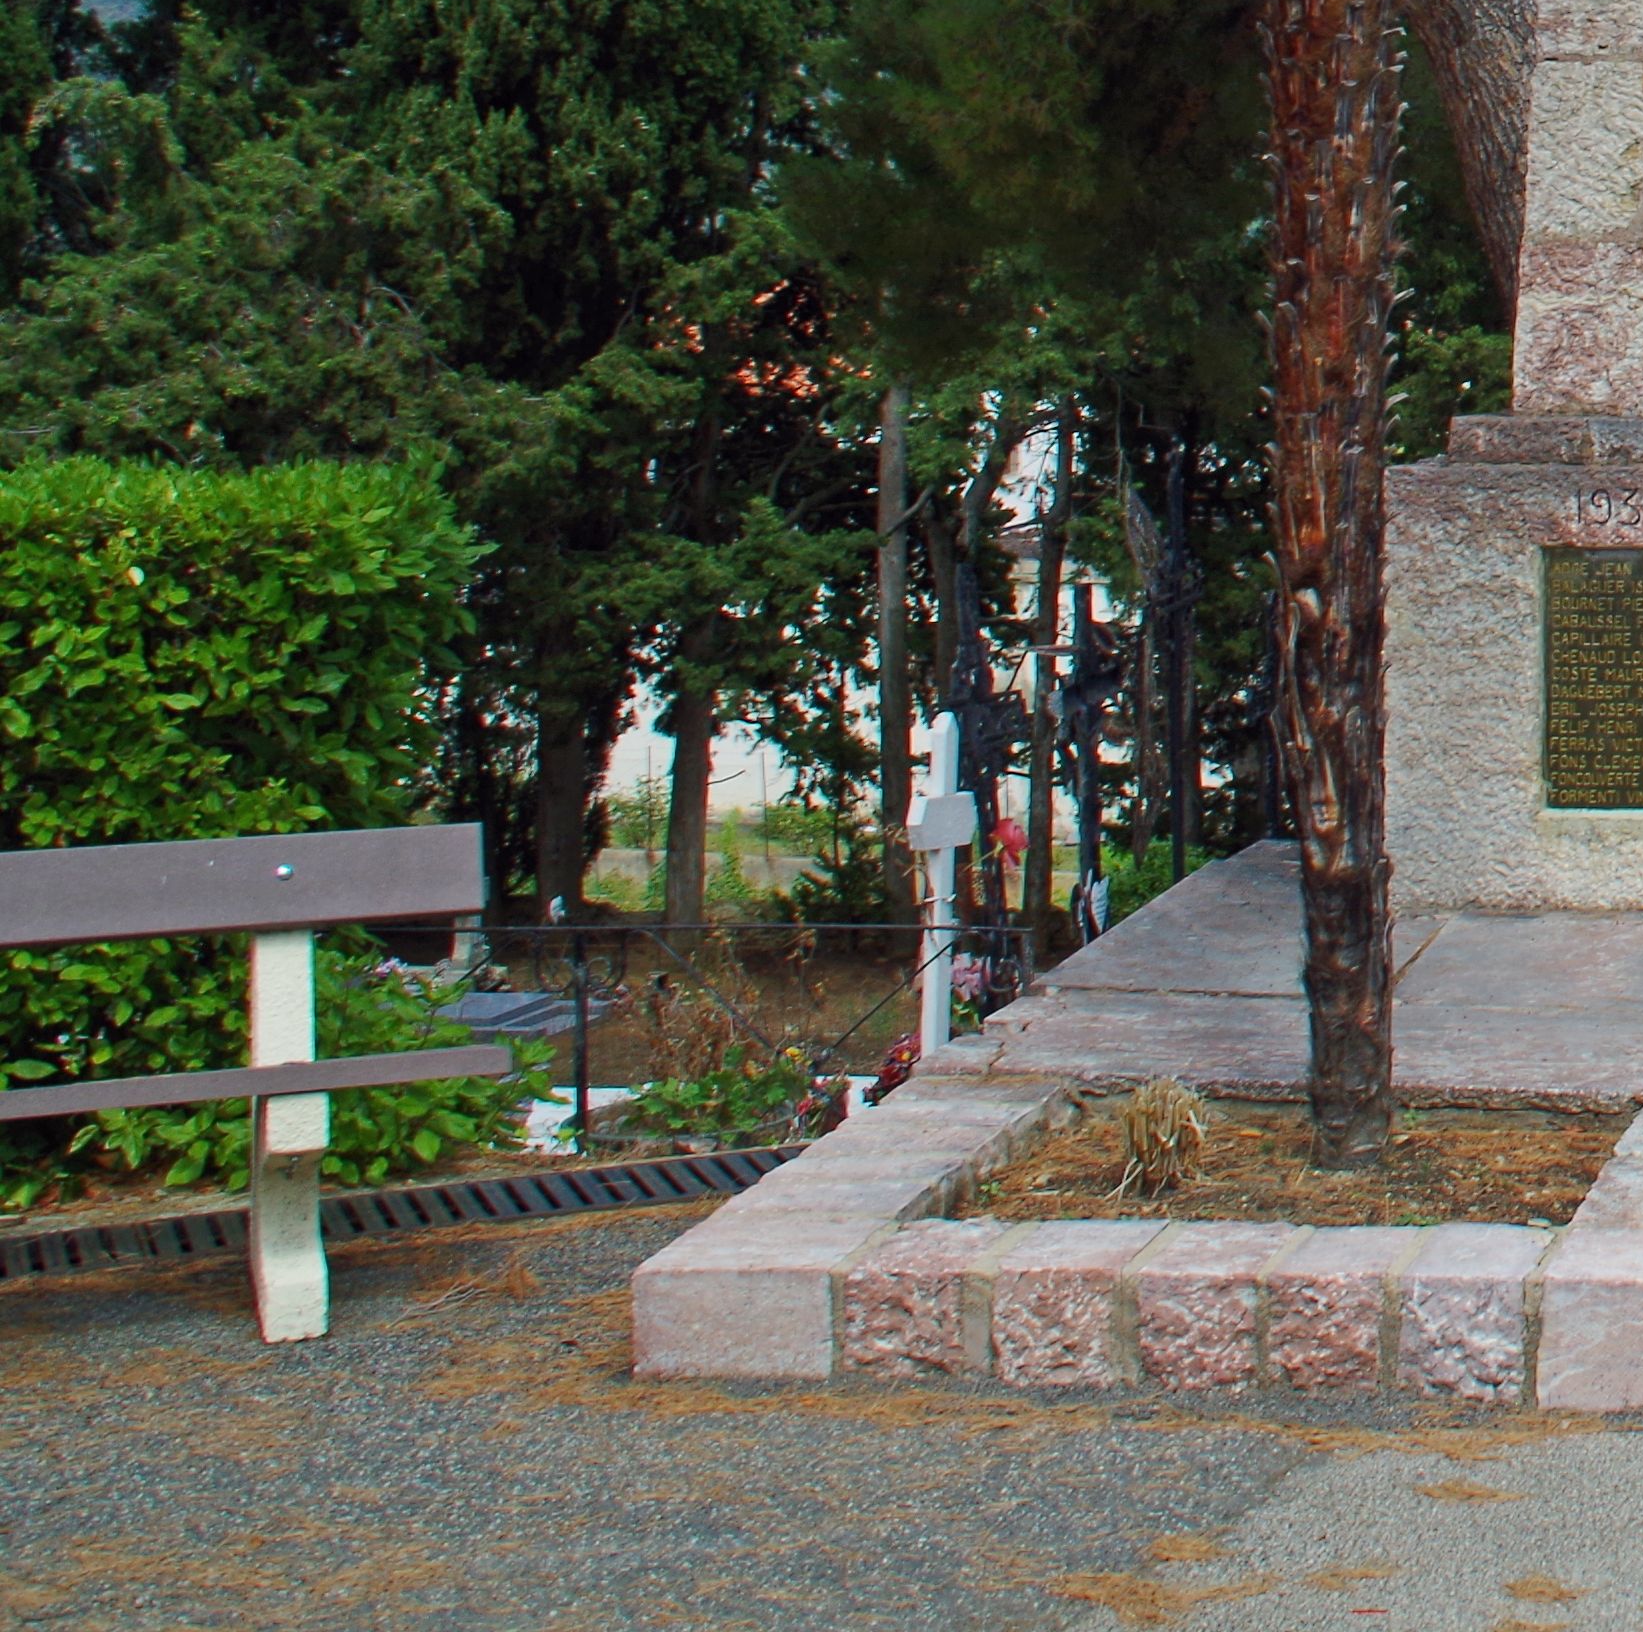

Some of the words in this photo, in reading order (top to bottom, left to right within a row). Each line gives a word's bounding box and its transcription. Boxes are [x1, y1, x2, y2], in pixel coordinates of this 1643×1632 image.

[1595, 562, 1632, 575] JEAN
[1551, 580, 1624, 593] BALAGUER
[1551, 597, 1614, 610] BOURNET
[1551, 615, 1630, 629] CABAUSSEL
[1551, 632, 1631, 646] CAPILLAIRE
[1552, 650, 1615, 663] CHENAUD
[1552, 668, 1597, 681] COSTE
[1551, 685, 1630, 699] DAGUEBERT
[1551, 702, 1580, 716] ERIL
[1590, 703, 1643, 716] JOSEPH
[1550, 719, 1590, 733] FELIP
[1597, 720, 1637, 734] HENRI
[1550, 737, 1605, 751] FERRAS
[1550, 755, 1586, 768] FONS
[1550, 790, 1620, 803] FORMENTI
